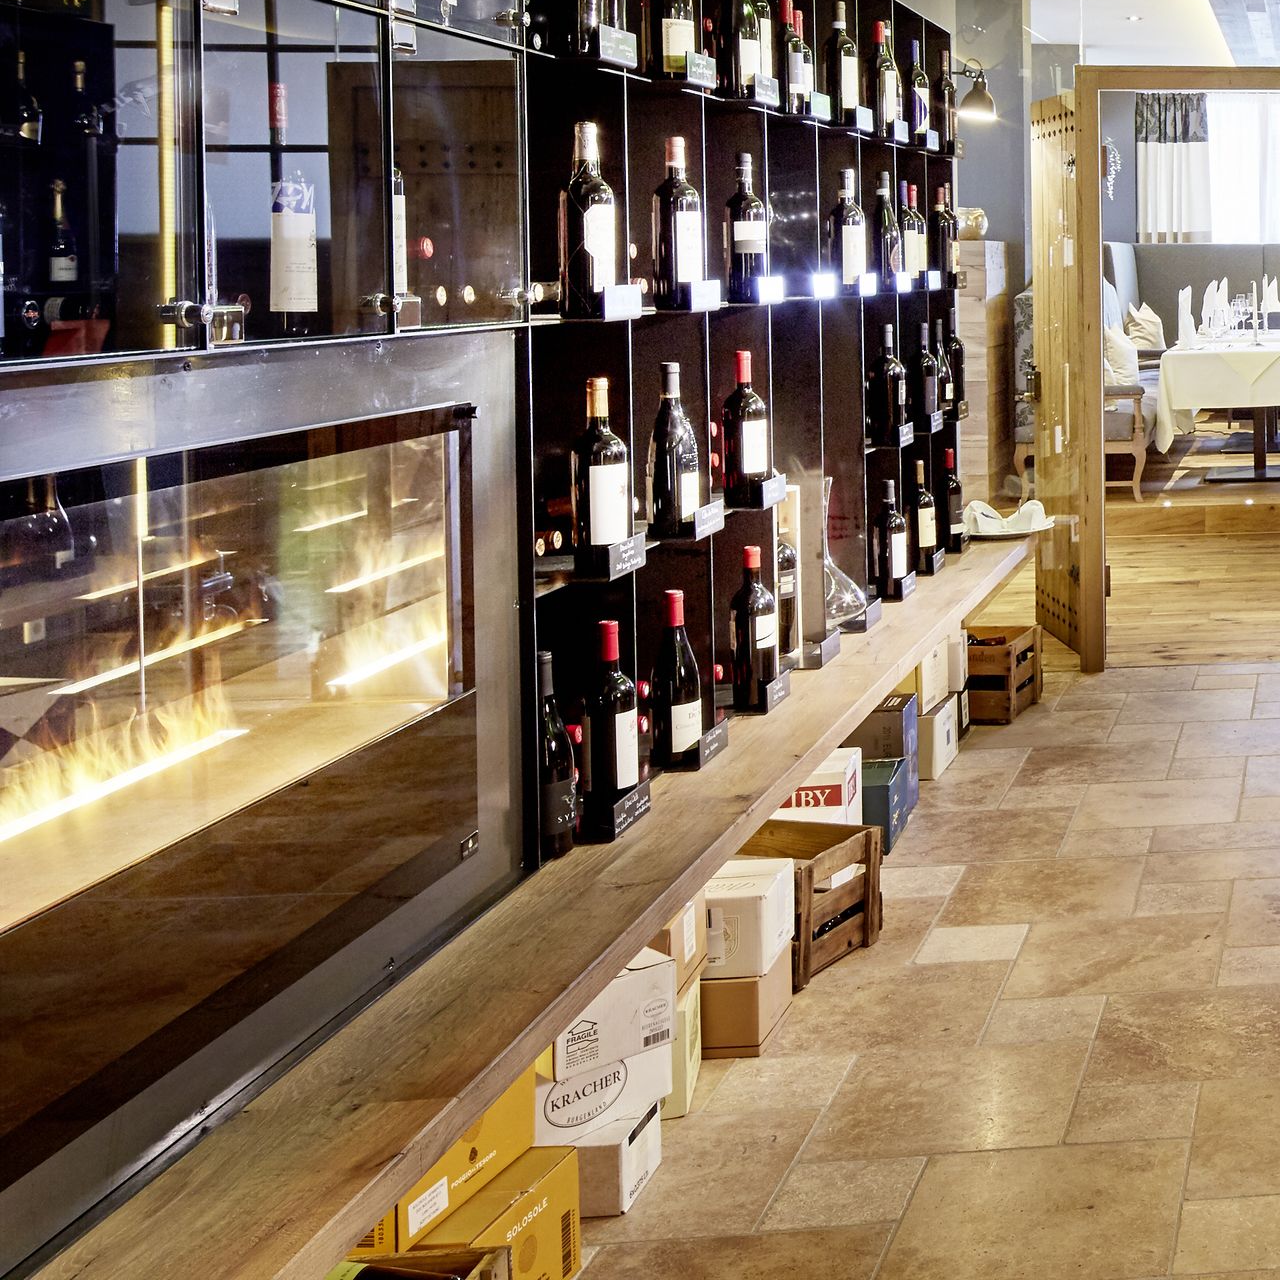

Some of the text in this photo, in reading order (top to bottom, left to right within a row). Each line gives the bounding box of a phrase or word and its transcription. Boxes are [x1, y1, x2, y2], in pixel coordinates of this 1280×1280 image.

[566, 1029, 599, 1045] FRAGILE
[550, 1070, 621, 1113] KRACHER
[506, 1197, 549, 1242] SOLOSOLE
